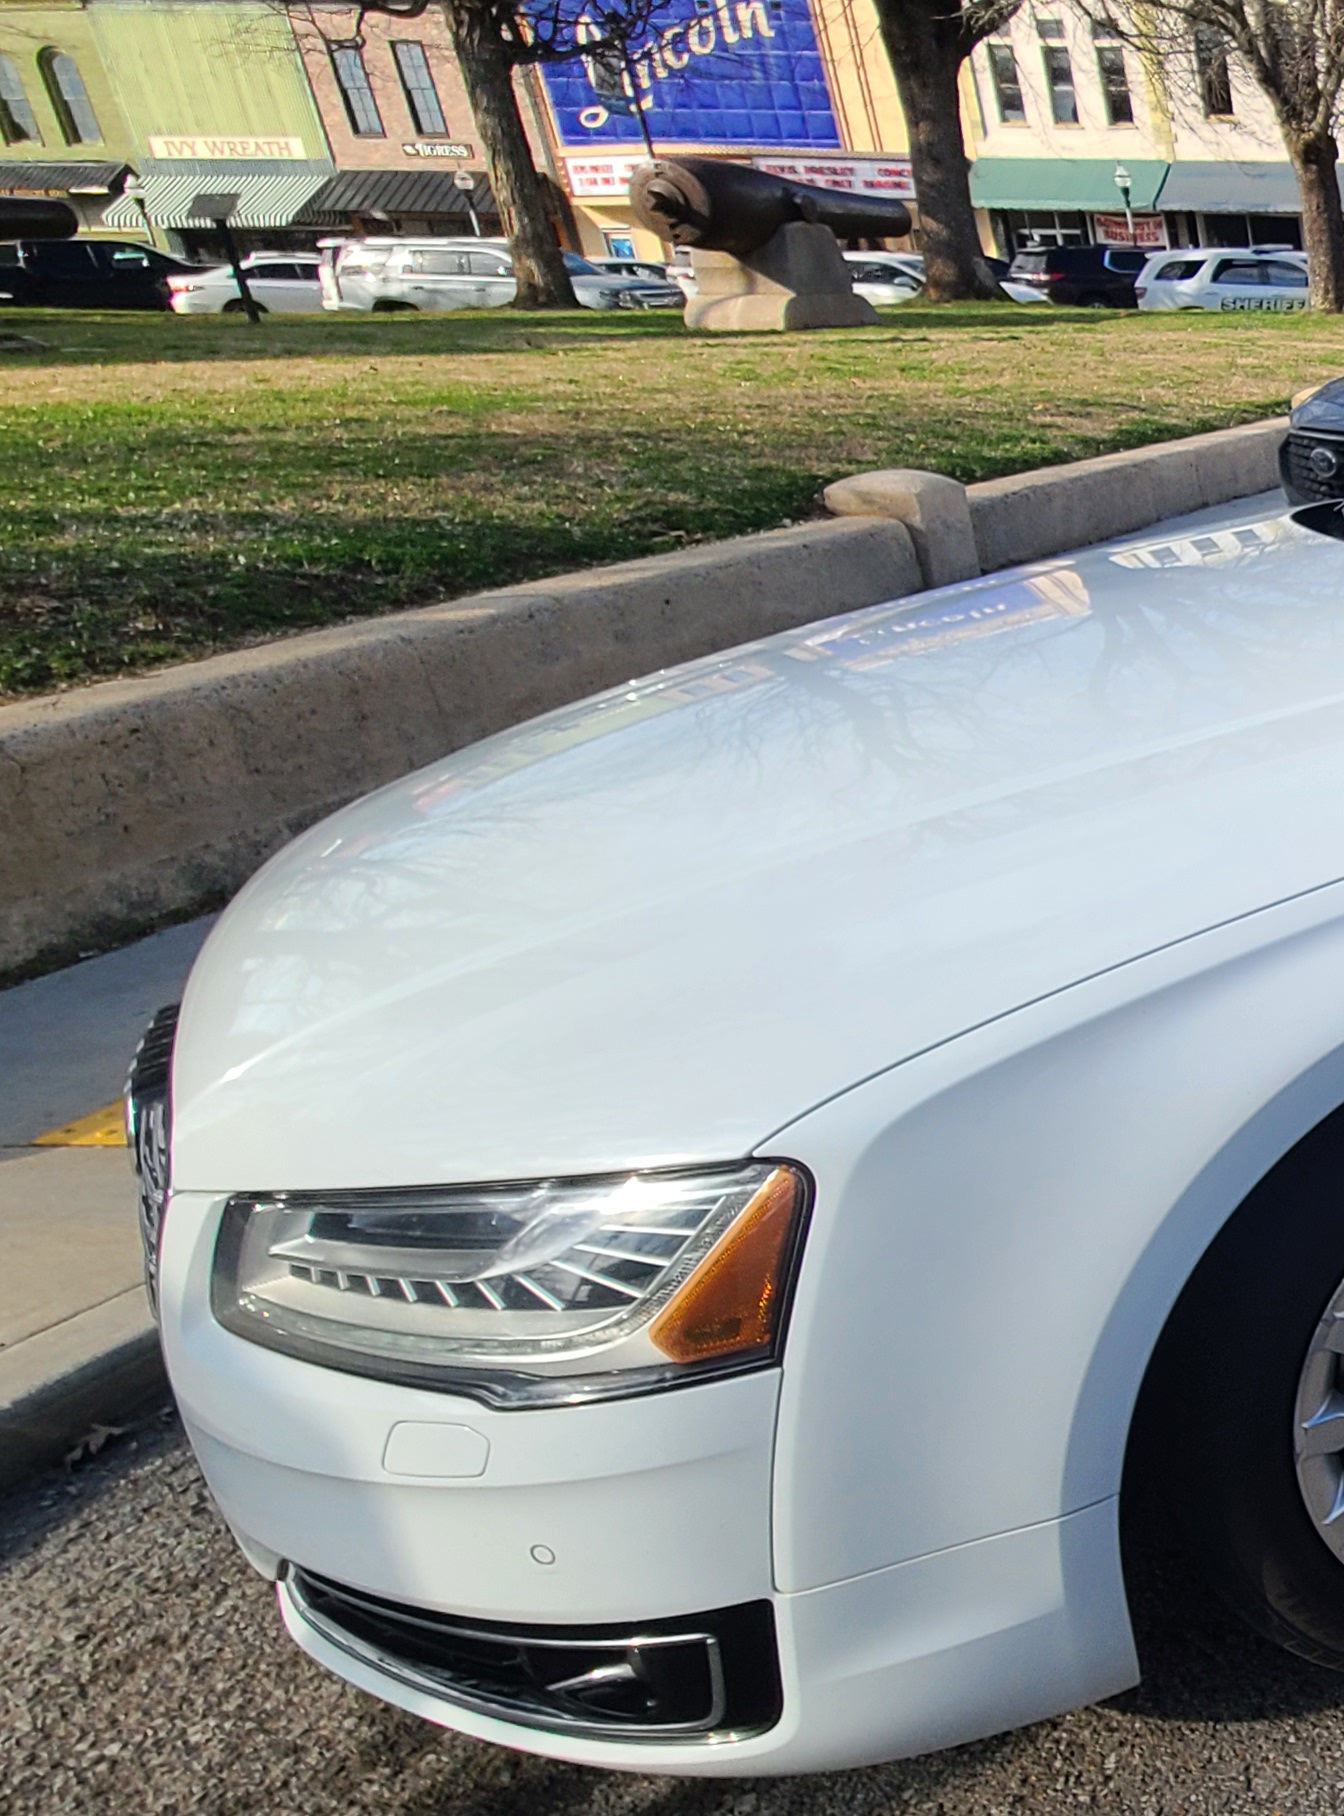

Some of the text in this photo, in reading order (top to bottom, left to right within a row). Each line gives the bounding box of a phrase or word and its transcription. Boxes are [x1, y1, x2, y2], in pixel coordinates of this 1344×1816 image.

[579, 0, 776, 128] Lincoln
[163, 140, 293, 157] IVY WREATH
[415, 143, 469, 157] TIGRESS
[1103, 229, 1159, 242] BUSINESS
[1221, 297, 1305, 312] SHERIFF
